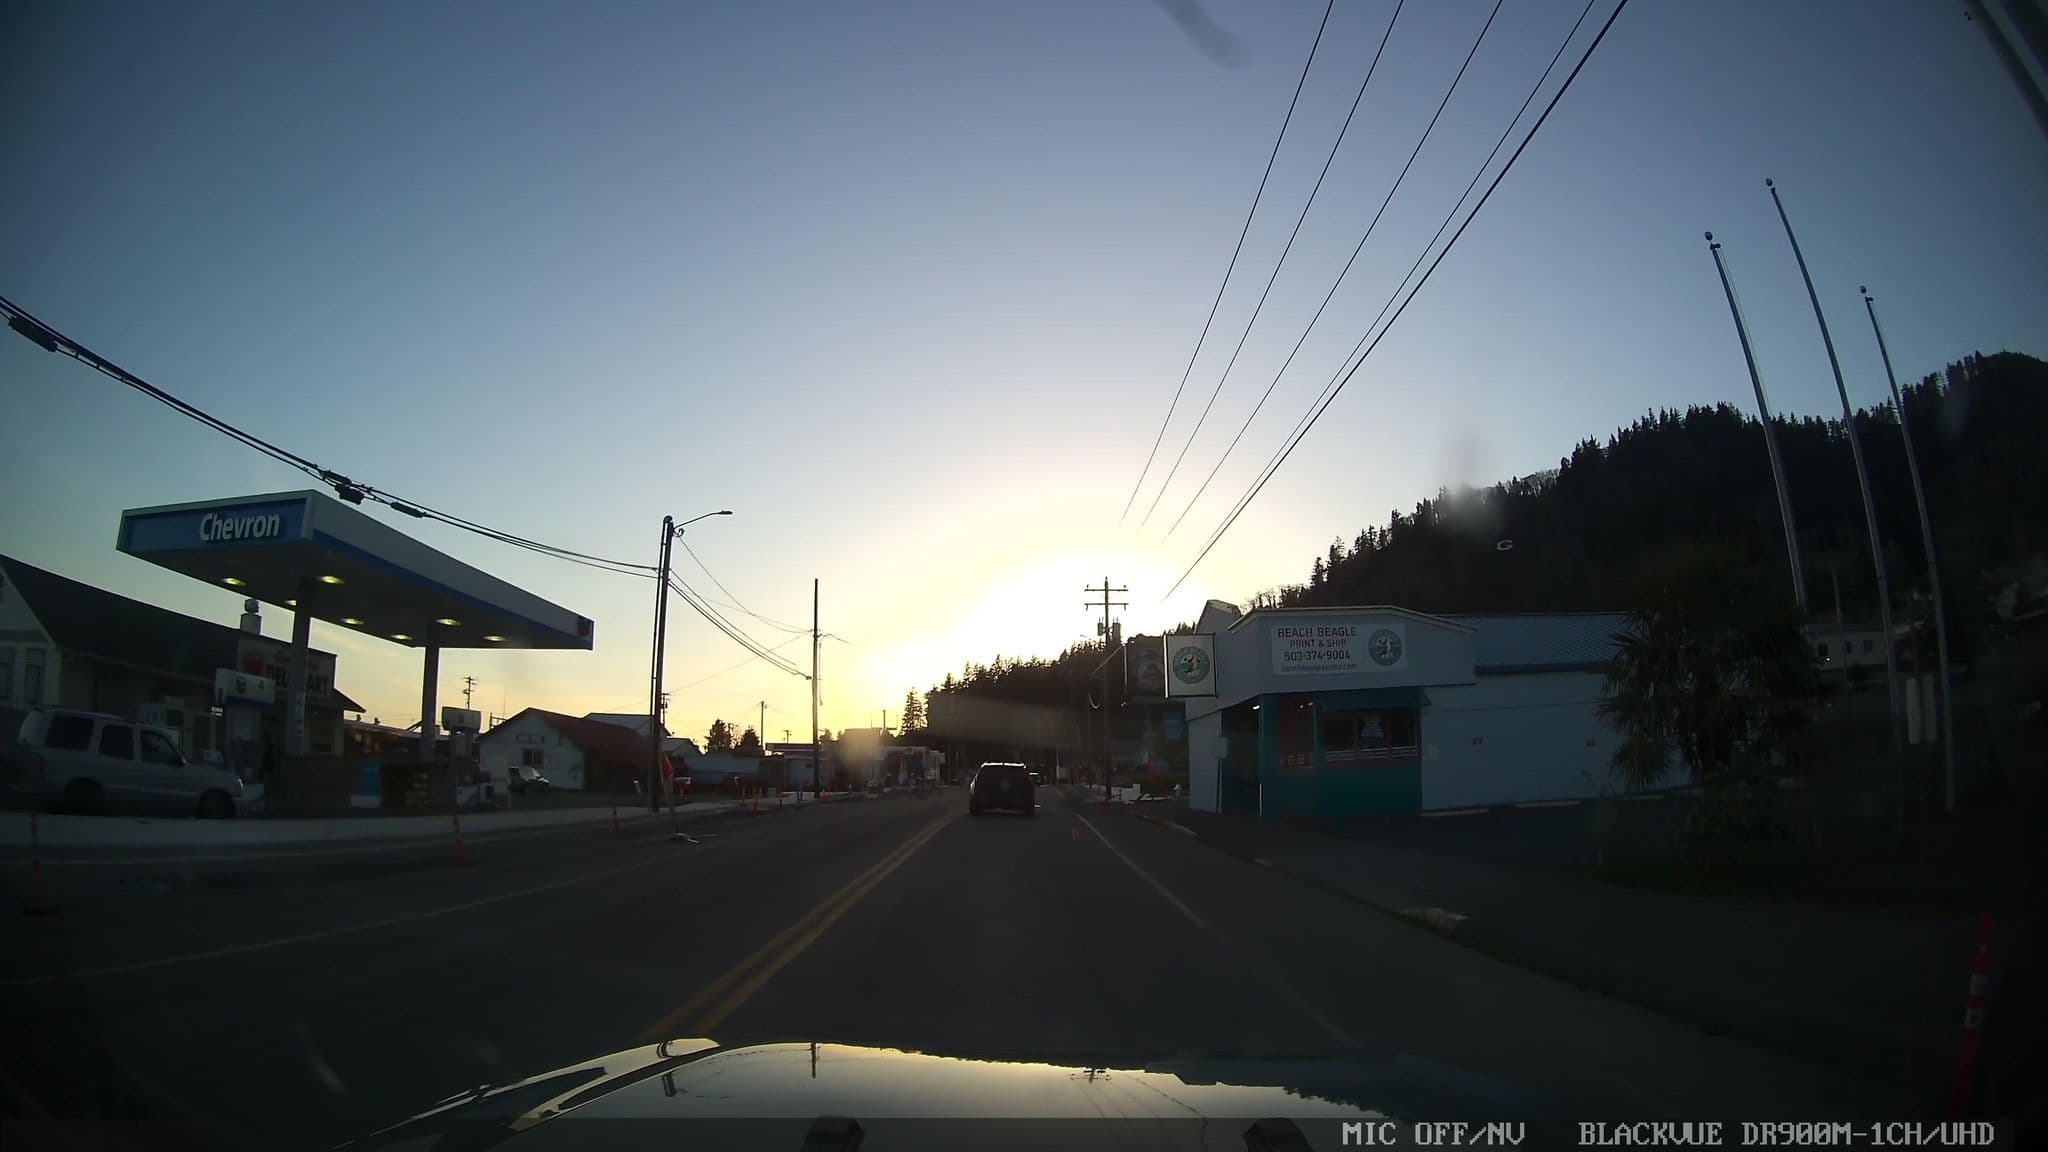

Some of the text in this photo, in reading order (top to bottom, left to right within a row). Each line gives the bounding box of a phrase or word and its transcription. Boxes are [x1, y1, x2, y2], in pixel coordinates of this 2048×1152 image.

[200, 512, 280, 541] Chevron
[1277, 627, 1357, 638] BEACH BEAGLE
[1290, 639, 1316, 648] PRINT
[1327, 639, 1347, 648] SHIP
